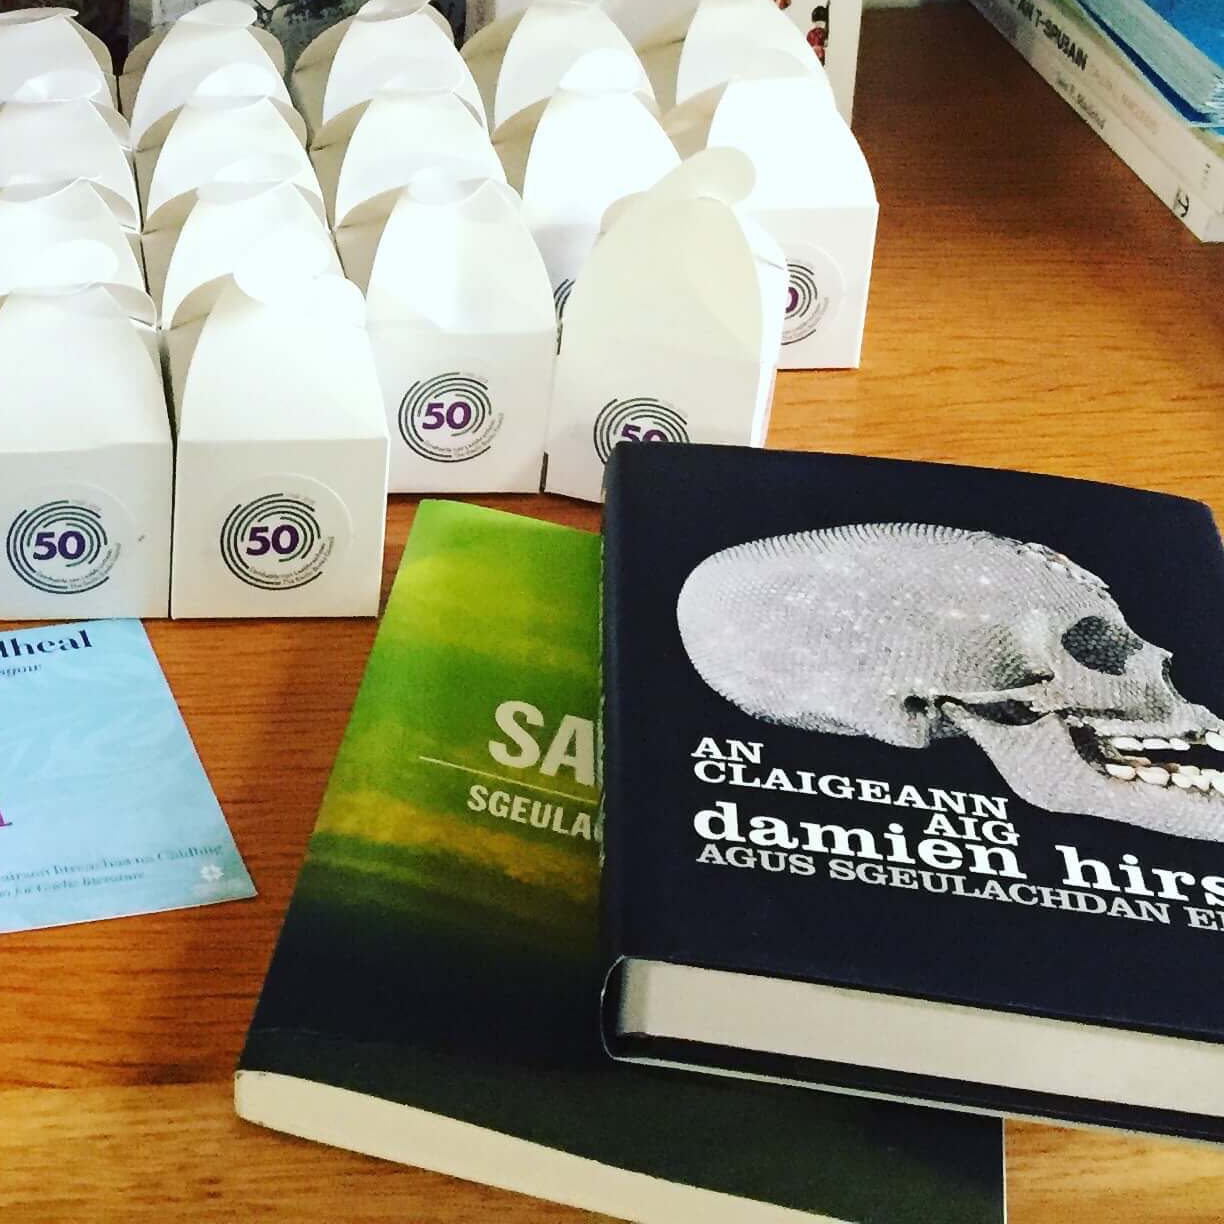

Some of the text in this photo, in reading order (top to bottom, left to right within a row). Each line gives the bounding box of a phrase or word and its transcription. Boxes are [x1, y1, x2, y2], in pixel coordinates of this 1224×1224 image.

[422, 401, 472, 430] 50
[33, 531, 86, 561] 50
[246, 524, 299, 556] 50
[691, 737, 764, 764] AN
[693, 760, 1008, 820] CLAIGEANN
[693, 801, 1027, 880] damien
[924, 813, 1020, 847] AIG
[696, 843, 816, 876] AGUS
[829, 859, 1170, 924] SGEULACHDAN
